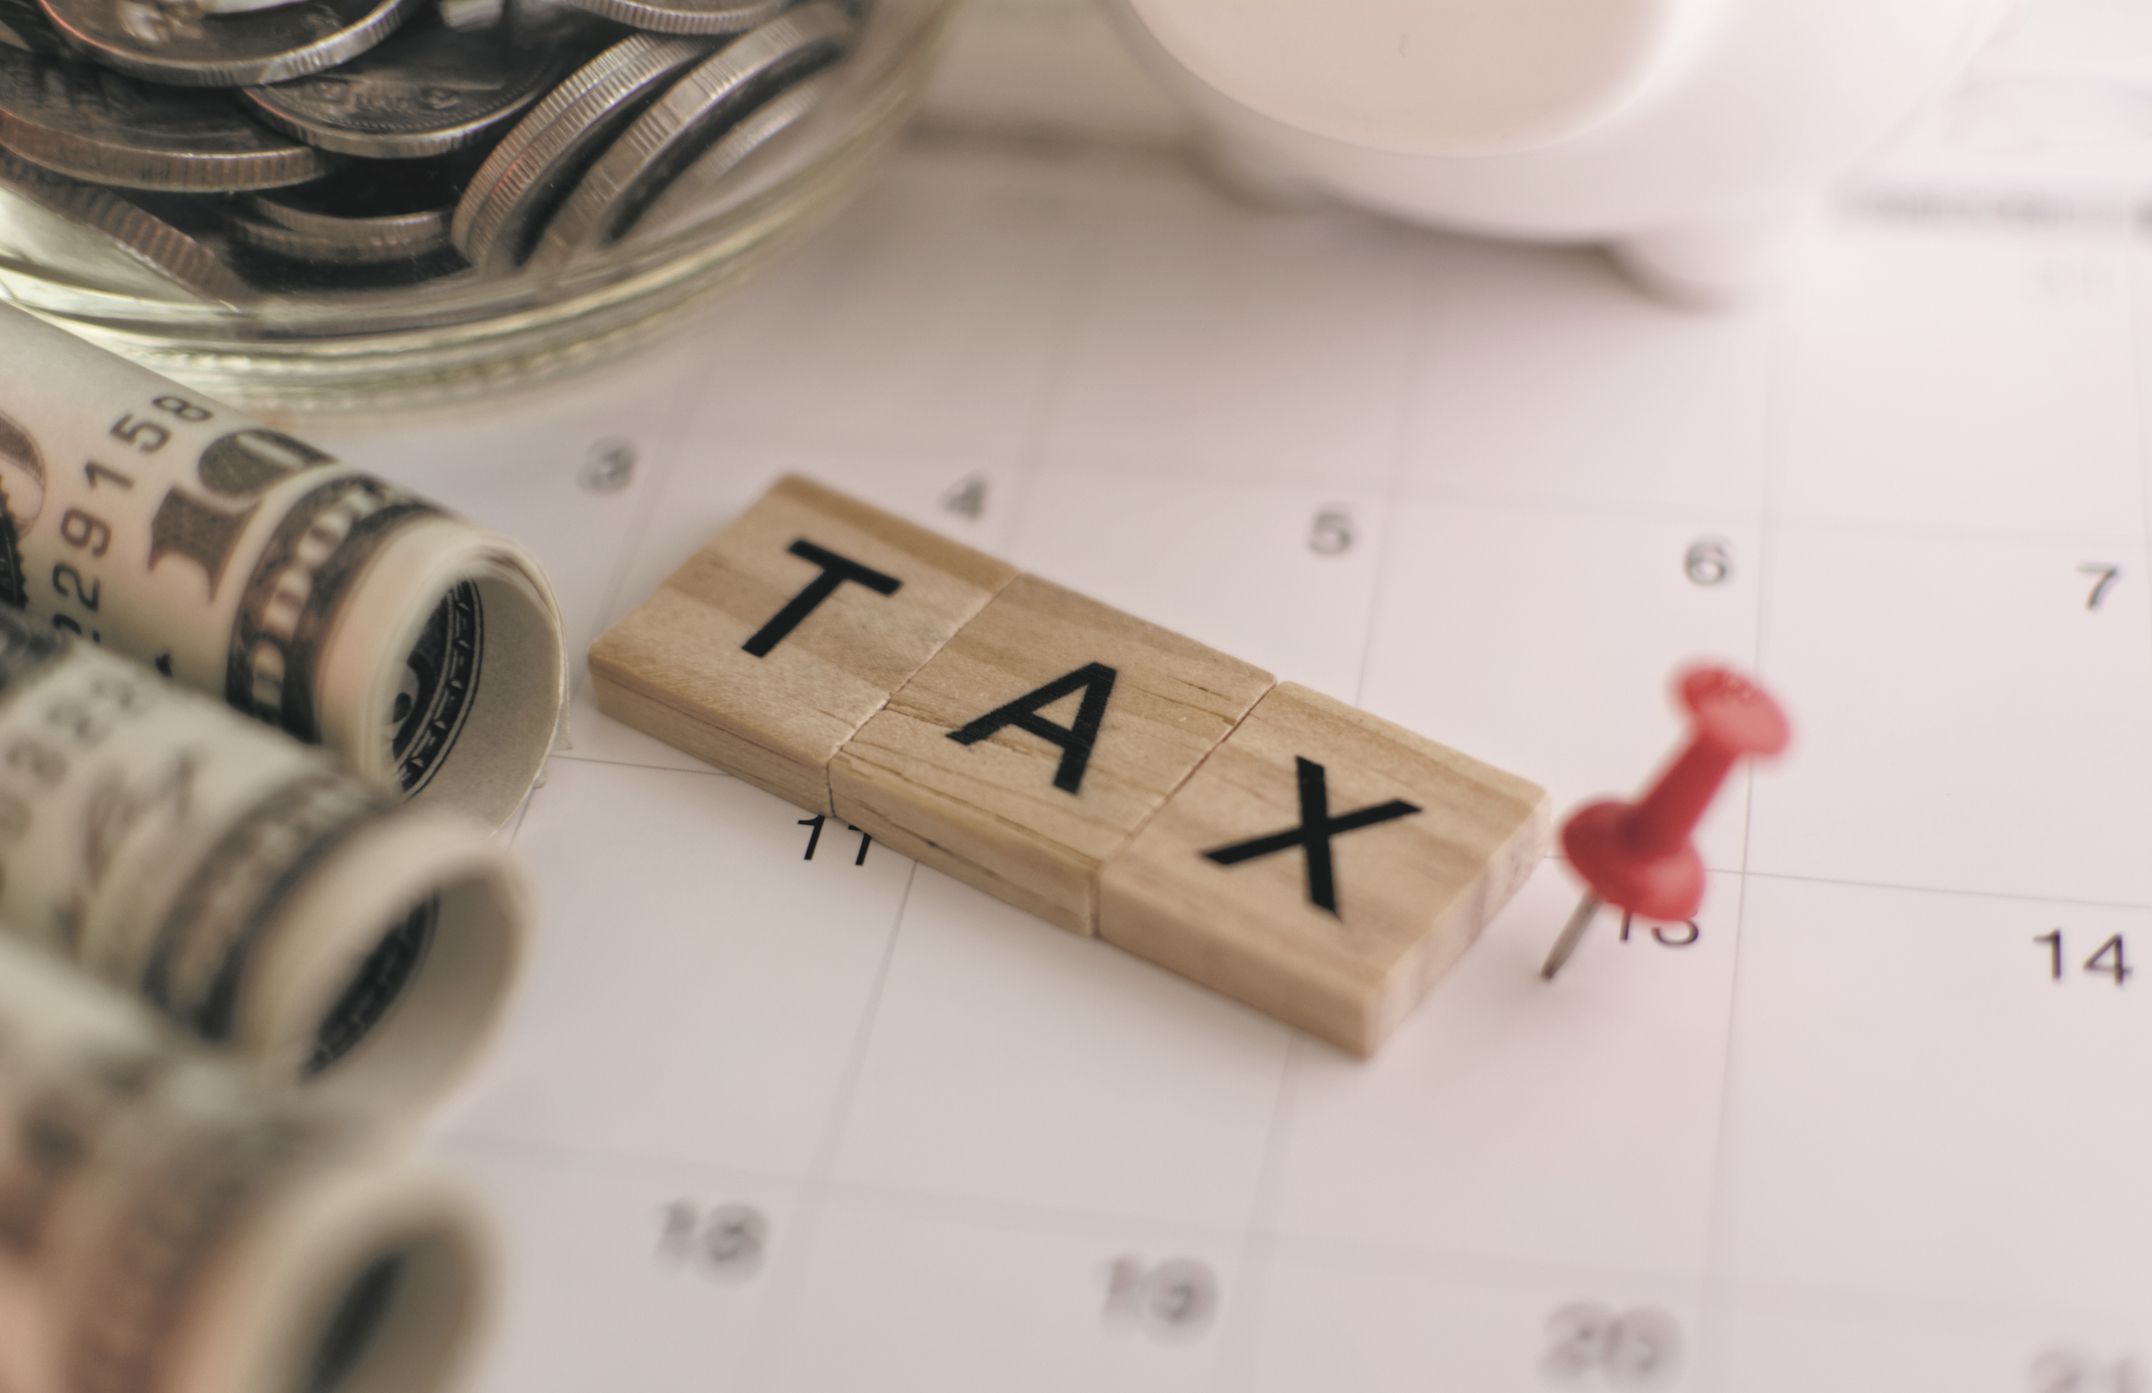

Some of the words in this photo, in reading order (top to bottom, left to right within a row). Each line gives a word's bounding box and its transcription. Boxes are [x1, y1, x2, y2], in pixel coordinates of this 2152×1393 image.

[940, 470, 989, 522] 4
[1307, 502, 1354, 557] 5
[1683, 537, 1733, 587] 6
[2076, 561, 2123, 612] 7
[740, 538, 1424, 925] TAX
[2033, 929, 2133, 985] 14
